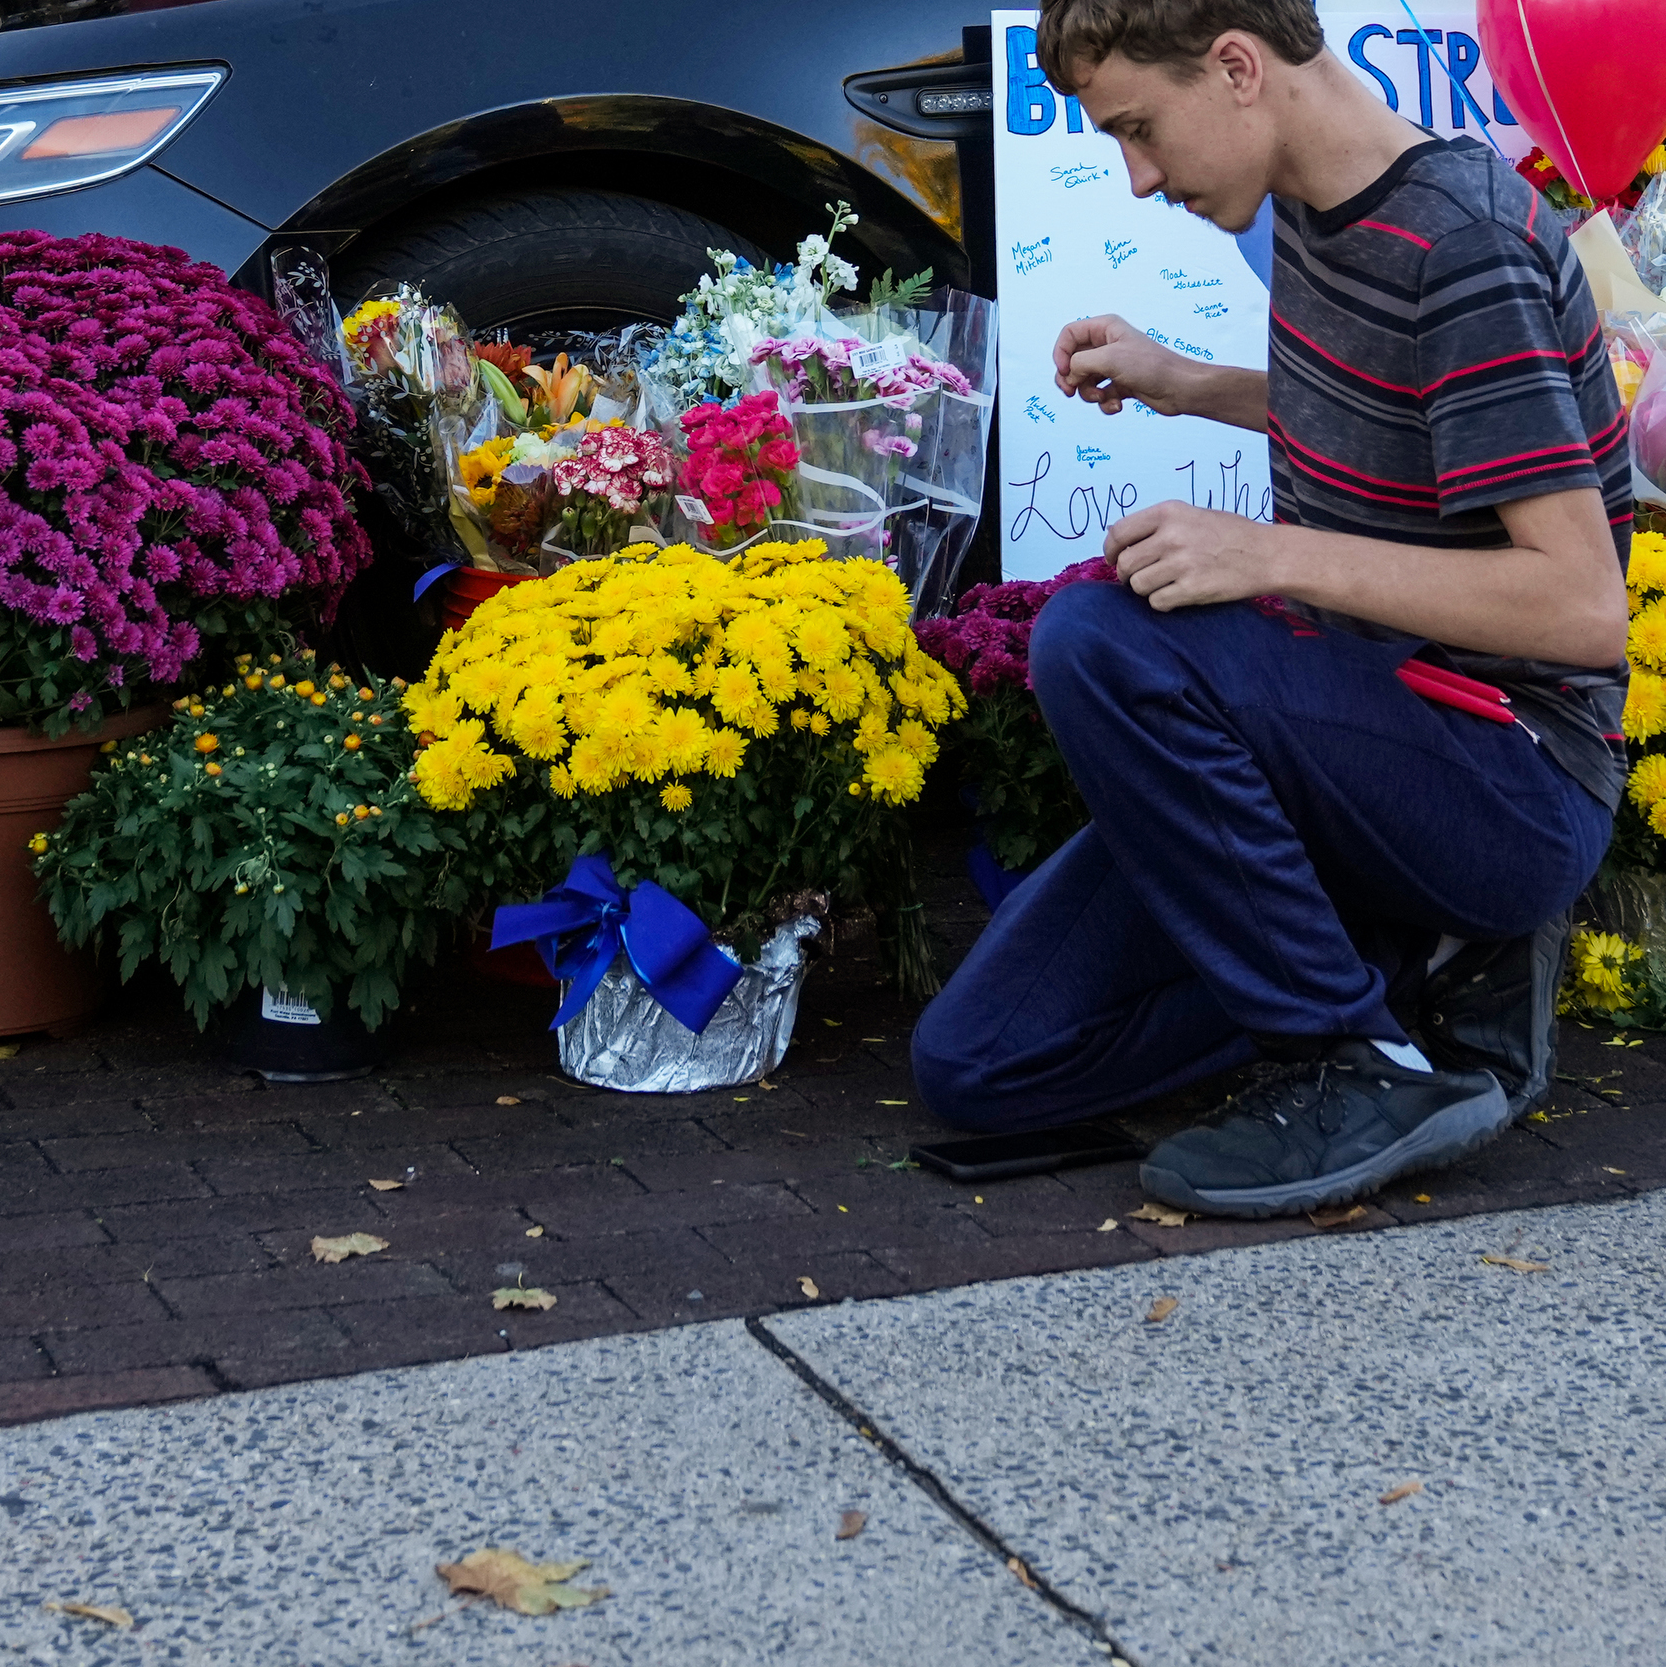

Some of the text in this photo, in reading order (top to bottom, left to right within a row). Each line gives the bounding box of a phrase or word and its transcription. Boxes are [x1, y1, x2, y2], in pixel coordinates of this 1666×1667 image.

[1050, 162, 1098, 181] Sarah
[1064, 172, 1100, 189] Quirk
[1012, 240, 1041, 260] Megan
[1015, 249, 1053, 276] Mitchell
[1159, 269, 1188, 281] Noah
[1193, 301, 1224, 315] Jeanne
[1173, 337, 1214, 361] Esposito
[1026, 395, 1056, 425] Michelle
[1009, 449, 1140, 542] Love
